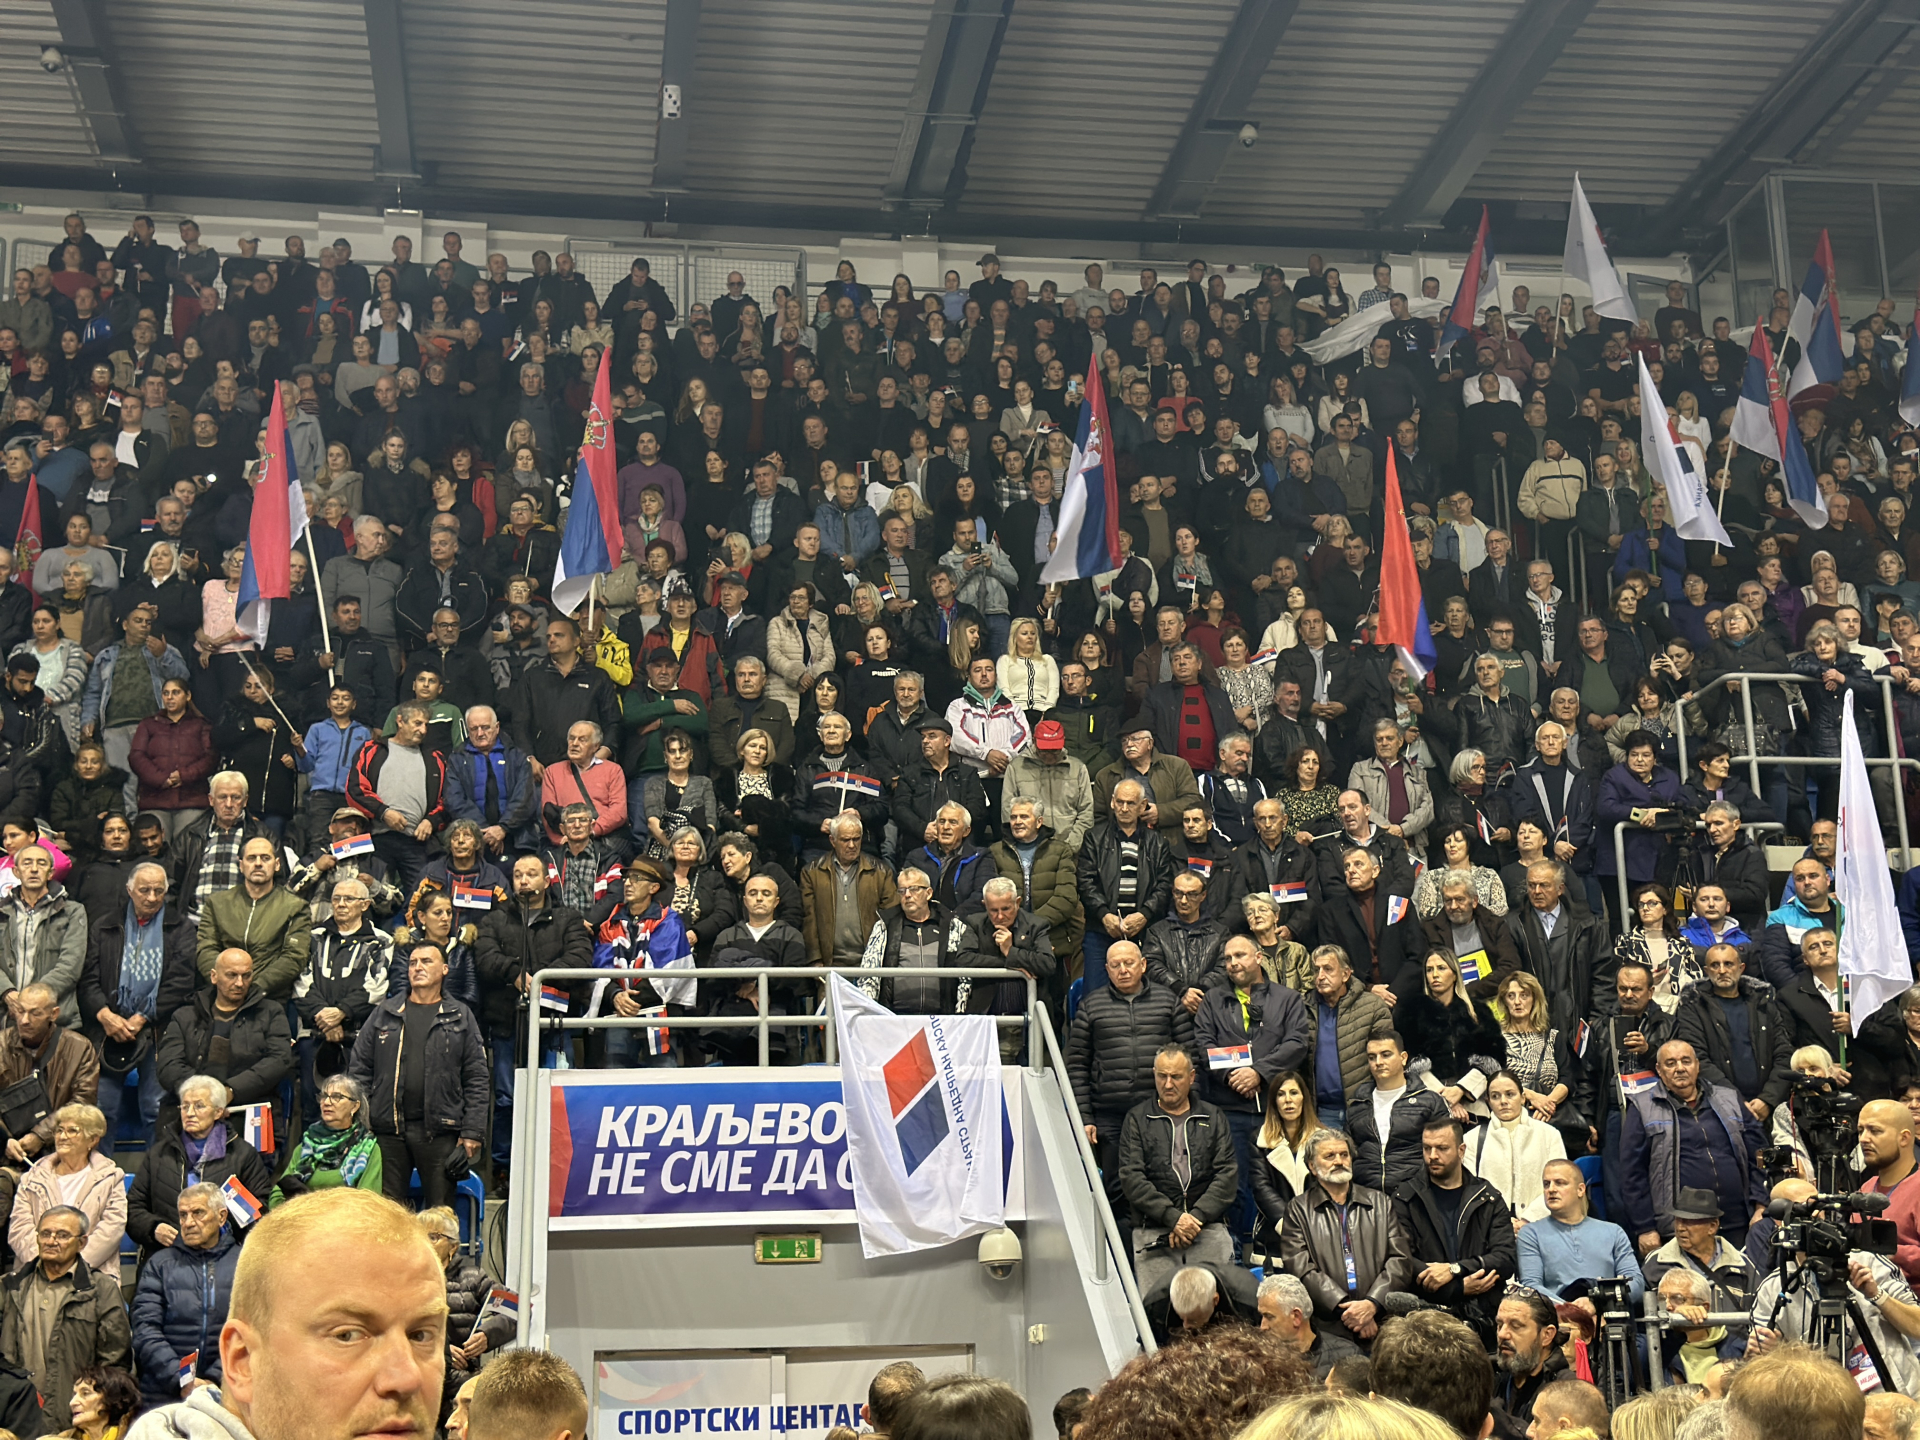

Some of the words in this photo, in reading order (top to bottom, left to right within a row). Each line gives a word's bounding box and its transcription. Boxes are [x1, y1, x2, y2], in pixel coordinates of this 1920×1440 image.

[595, 1101, 847, 1148] КРАЉЕВО
[588, 1152, 651, 1195] НЕ
[660, 1150, 757, 1194] СМЕ
[761, 1148, 828, 1195] ДА
[618, 1406, 760, 1435] СПОРТСКИ
[770, 1403, 865, 1433] ЦЕНТАР
